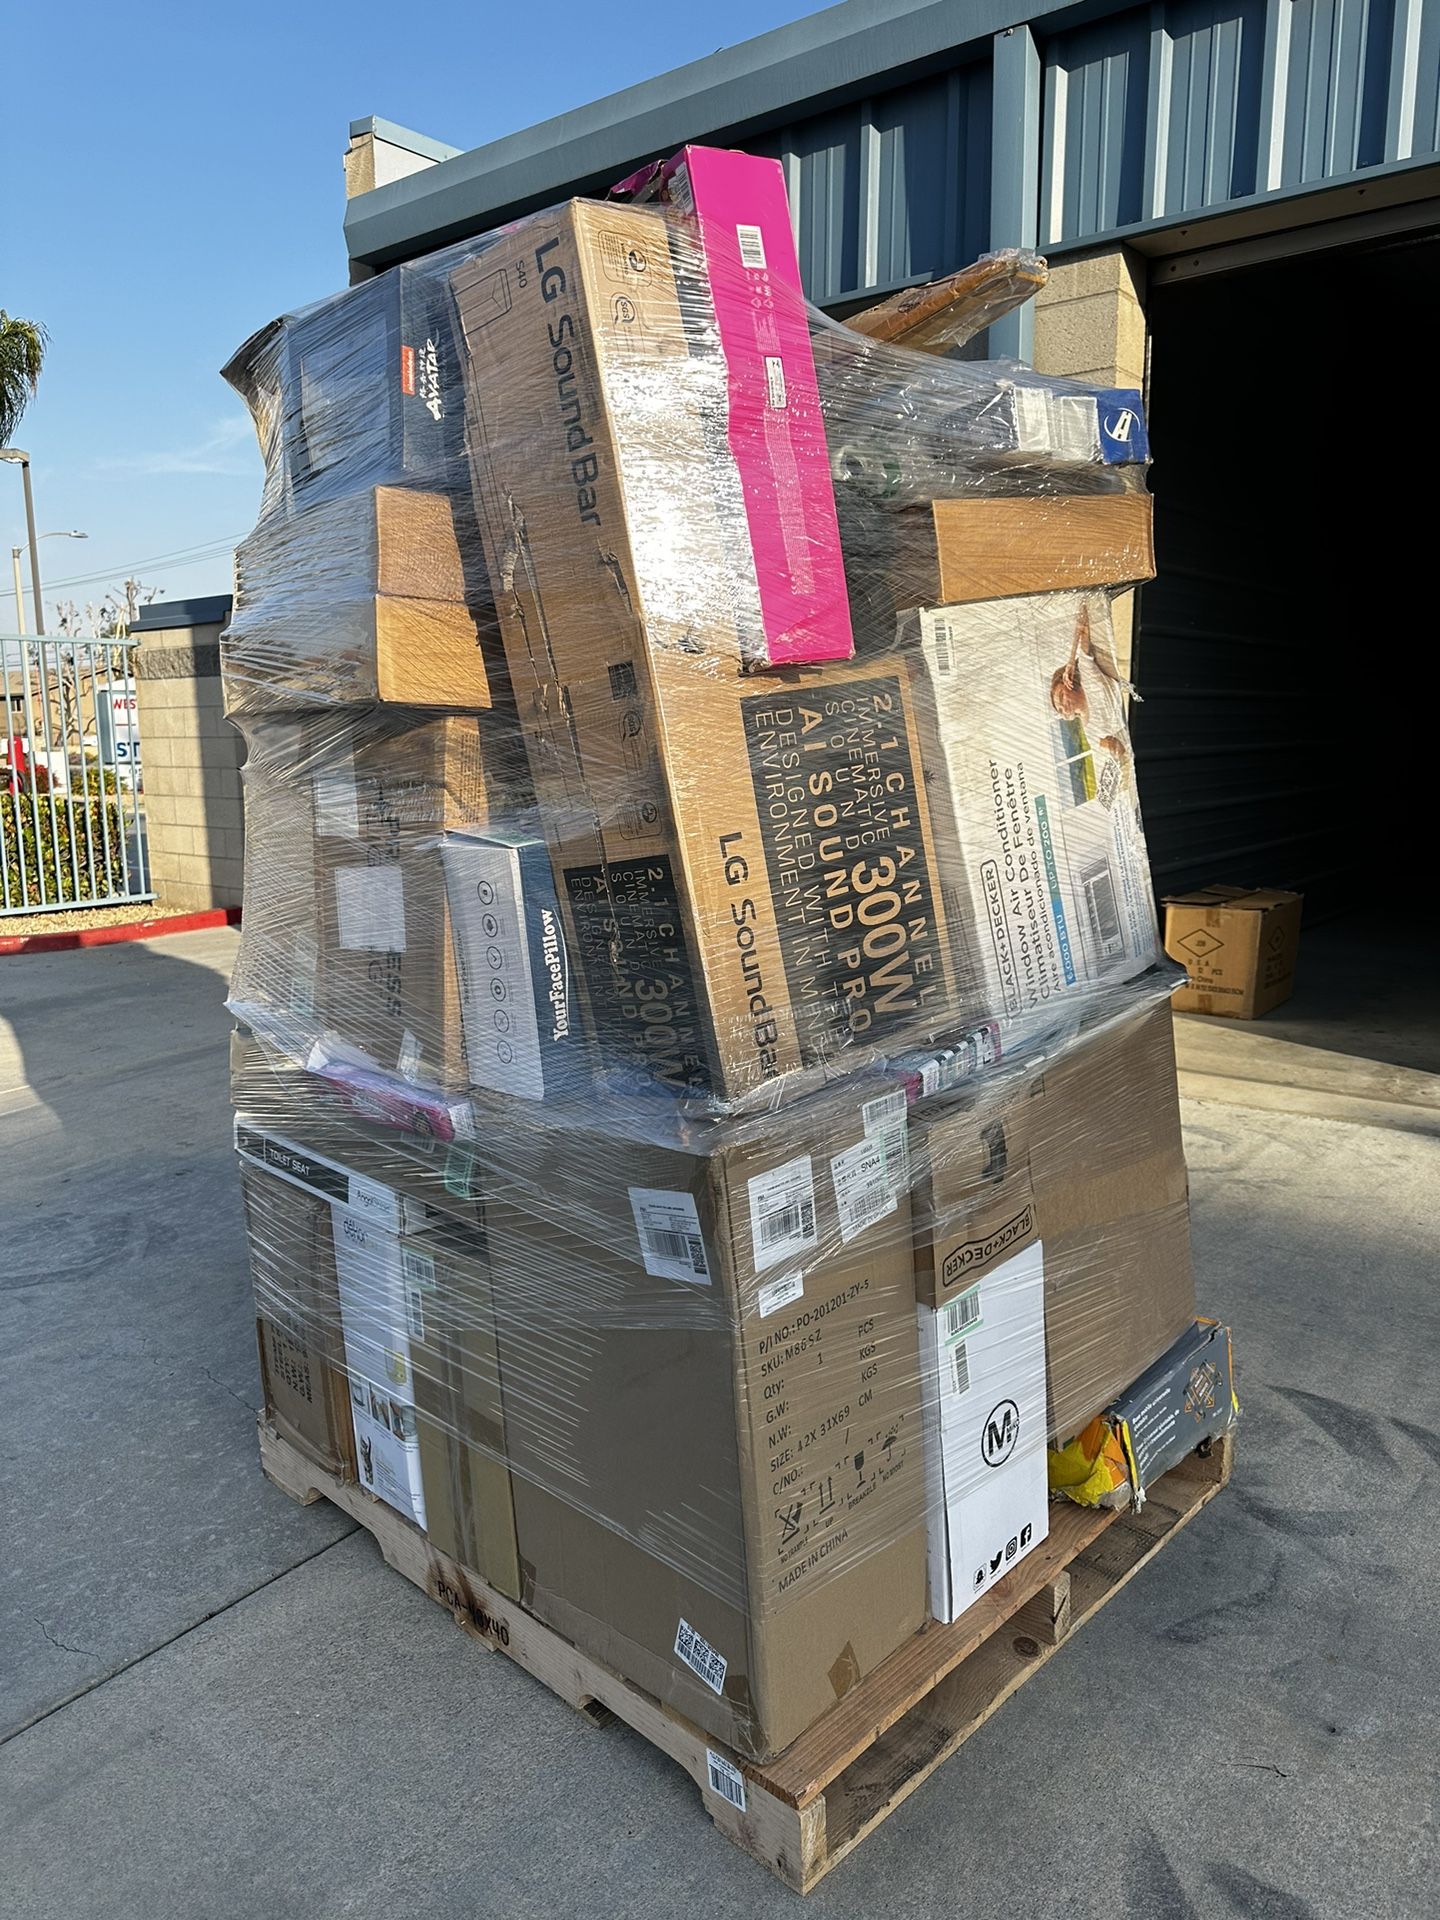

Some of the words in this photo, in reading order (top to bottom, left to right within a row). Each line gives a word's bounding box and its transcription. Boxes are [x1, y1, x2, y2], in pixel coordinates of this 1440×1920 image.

[515, 260, 527, 289] S40
[534, 236, 567, 304] LG
[620, 301, 630, 319] SGS
[426, 330, 442, 421] AVATAR
[798, 706, 827, 751] AI
[856, 697, 891, 839] IMMERSIVE
[841, 700, 875, 845] CINEMATIC
[1003, 768, 1023, 848] Fenêtre
[1016, 762, 1030, 823] ventana
[718, 832, 749, 887] LG
[755, 711, 806, 924] ENVIRONMENT
[792, 937, 812, 966] IN
[775, 708, 816, 870] DESIGNED
[803, 884, 832, 968] WITH
[808, 771, 854, 930] SOUND
[825, 702, 860, 850] SOUND
[851, 856, 918, 1013] 300W
[873, 694, 898, 750] 2.1
[886, 772, 937, 1005] CHANNEL
[989, 760, 1015, 881] Conditioner
[1026, 828, 1035, 847] de
[1044, 849, 1055, 872] TO
[1010, 891, 1023, 916] Air
[1019, 855, 1029, 881] De
[1032, 852, 1055, 959] acondicionado
[1048, 875, 1057, 889] UP
[622, 871, 654, 971] CINEMATIC
[633, 870, 664, 969] IMMERSIVE
[984, 868, 1018, 1012] BLACK+DECKER
[1026, 890, 1049, 1000] Climatiseur
[1056, 914, 1067, 941] BTU
[541, 908, 569, 1042] YourFacePillow
[611, 872, 641, 972] SOUND
[635, 979, 686, 1088] 300W
[837, 947, 872, 1032] PRO
[1017, 927, 1038, 1009] Window
[1052, 965, 1061, 992] Aire
[270, 1149, 290, 1167] TOILET
[292, 1161, 310, 1176] SEAT
[945, 1216, 1030, 1277] BLACK+DECKER
[796, 1280, 869, 1331] PO-201201-ZY-5
[761, 1355, 784, 1377] SKU:
[763, 1379, 785, 1400] Qty:
[817, 1352, 823, 1365] 1
[858, 1319, 874, 1337] PCS
[766, 1401, 789, 1424] G.W:
[859, 1344, 876, 1360] KGS
[768, 1424, 791, 1449] N.W:
[861, 1363, 878, 1383] KGS
[770, 1449, 794, 1473] SIZE:
[858, 1389, 873, 1407] CM
[778, 1562, 807, 1593] MADE
[808, 1551, 819, 1568] IN
[819, 1529, 848, 1558] CHINA
